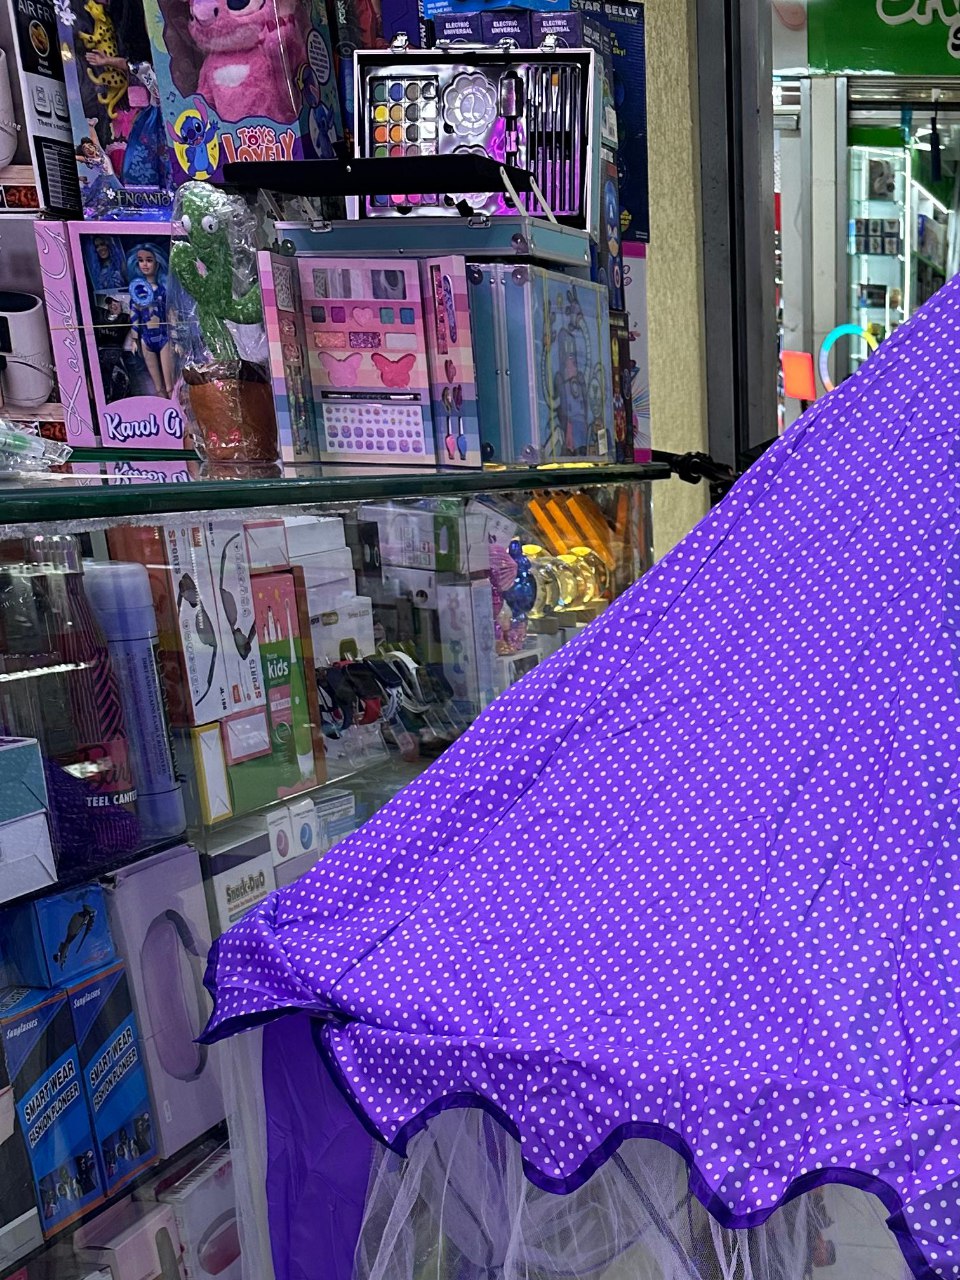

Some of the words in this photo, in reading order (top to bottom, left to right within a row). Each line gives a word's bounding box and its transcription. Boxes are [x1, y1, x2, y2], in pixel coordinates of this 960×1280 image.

[571, 0, 600, 12] STAR
[605, 4, 638, 18] BELLY
[443, 27, 473, 35] UNIVERSAL
[445, 21, 470, 29] ELECTRIC
[491, 26, 521, 34] UNIVERSAL
[493, 20, 518, 28] ELECTRIC
[542, 19, 568, 27] ELECTRIC
[237, 126, 276, 146] TOYS
[116, 189, 171, 206] ENCANTO
[104, 412, 159, 441] Karol
[163, 408, 182, 438] G
[167, 530, 182, 575] SPORTS
[249, 658, 262, 699] SPORTS
[267, 659, 289, 679] kids
[86, 796, 110, 807] TEEL
[73, 988, 101, 1009] Sunglasses
[6, 1018, 39, 1039] Sunglasses
[89, 1056, 113, 1088] SMART
[111, 1026, 134, 1061] WEAR
[24, 1083, 51, 1124] SMART
[49, 1058, 76, 1096] WEAR
[92, 1077, 114, 1112] FASHION
[29, 1111, 52, 1149] FASHION
